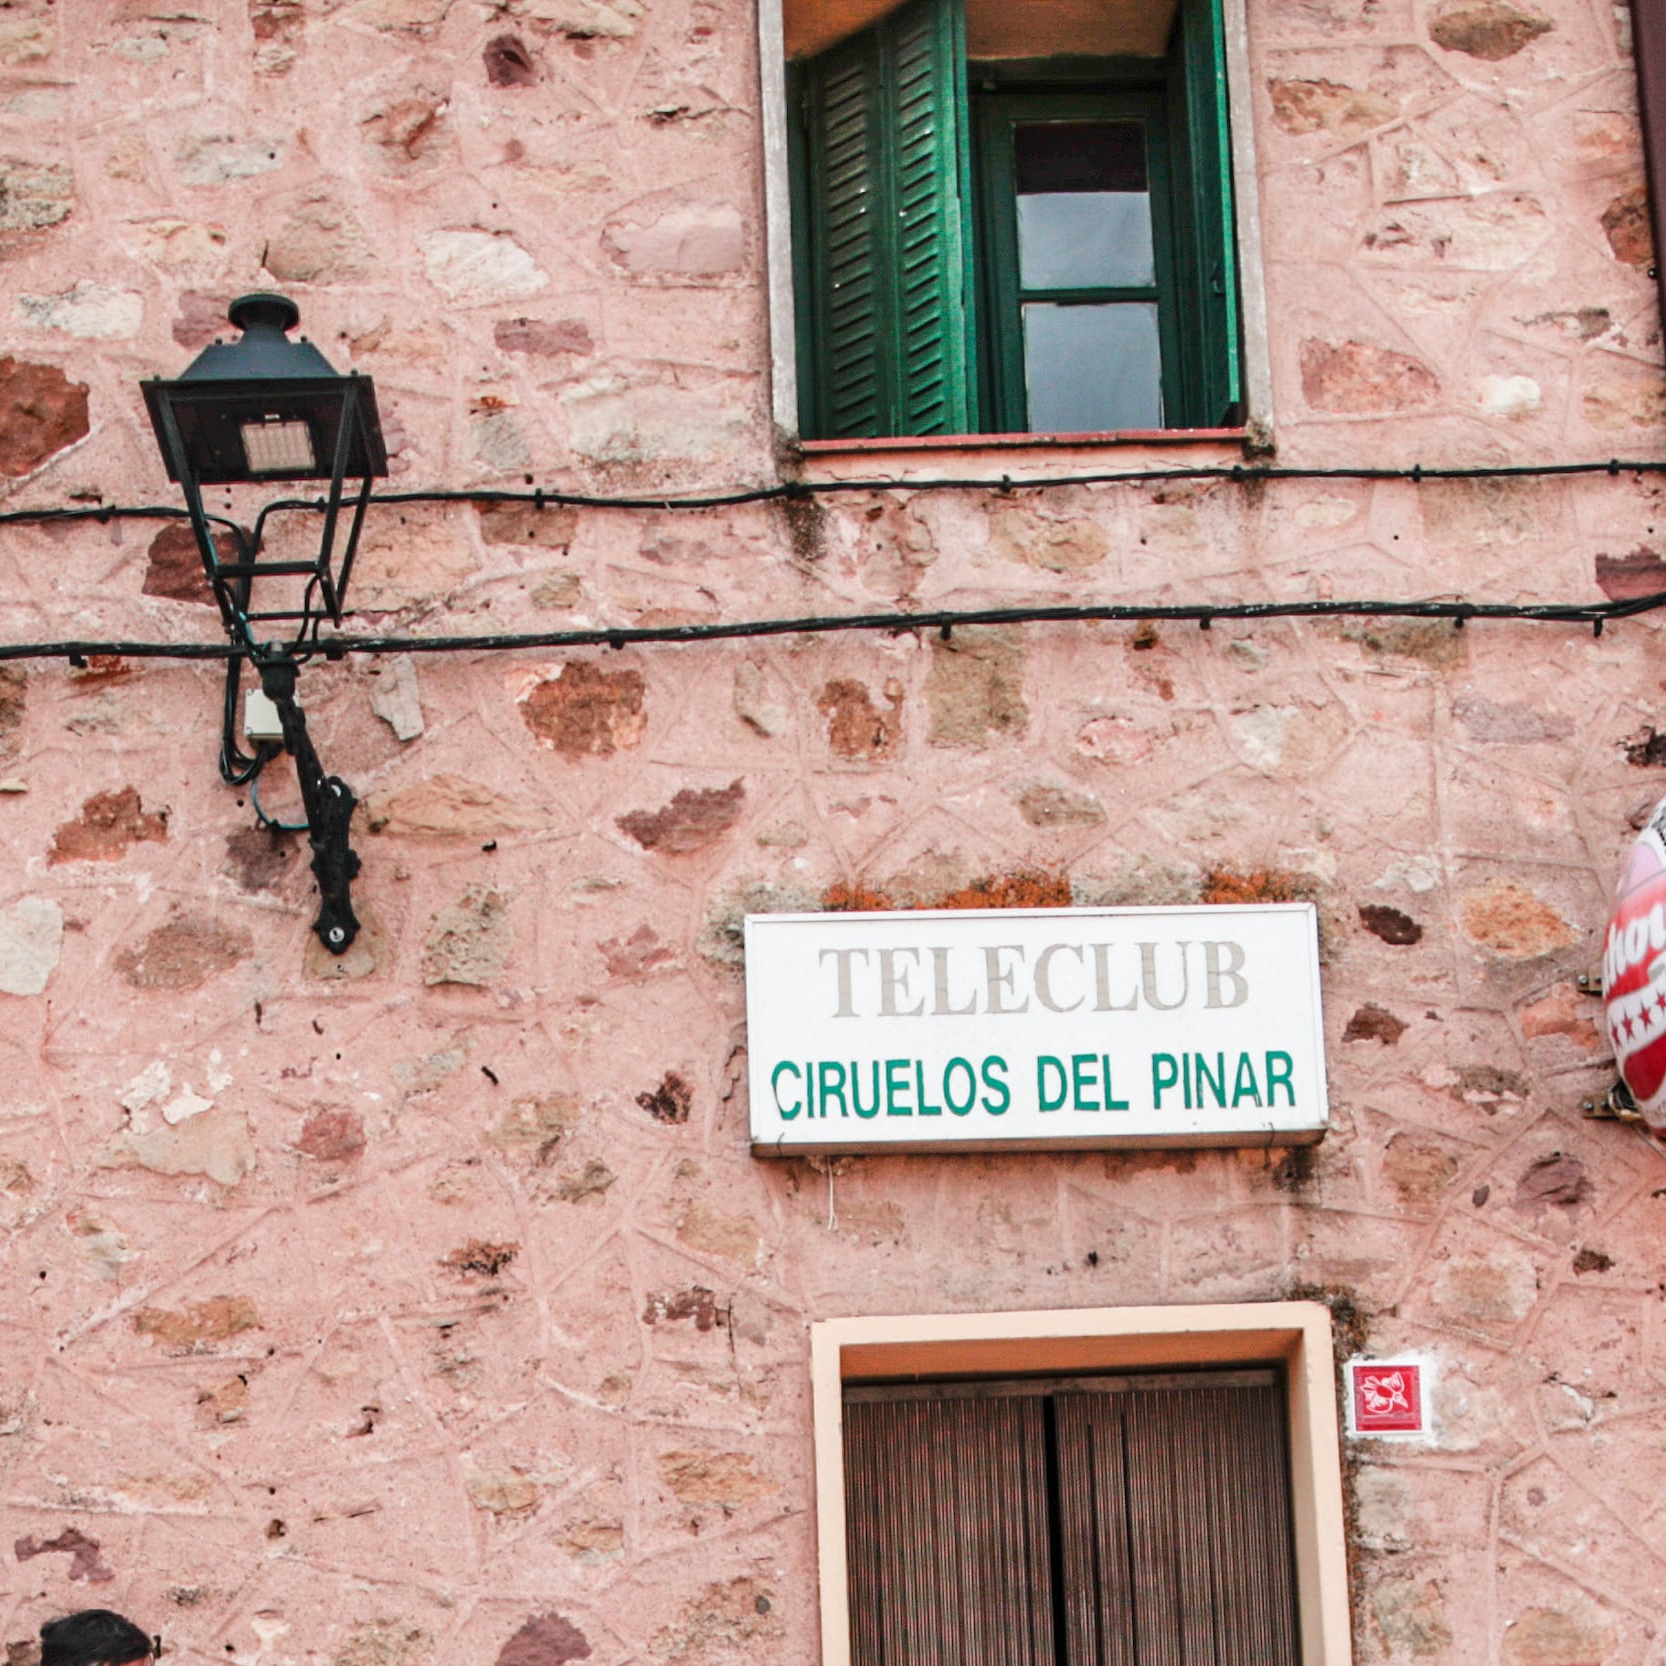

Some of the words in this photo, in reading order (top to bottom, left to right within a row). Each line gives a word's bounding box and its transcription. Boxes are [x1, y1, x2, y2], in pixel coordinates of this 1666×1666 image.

[818, 940, 1250, 1019] TELECLUB
[770, 1054, 1012, 1121] CIRUELOS
[1036, 1053, 1130, 1113] DEL
[1151, 1049, 1297, 1110] PINAR
